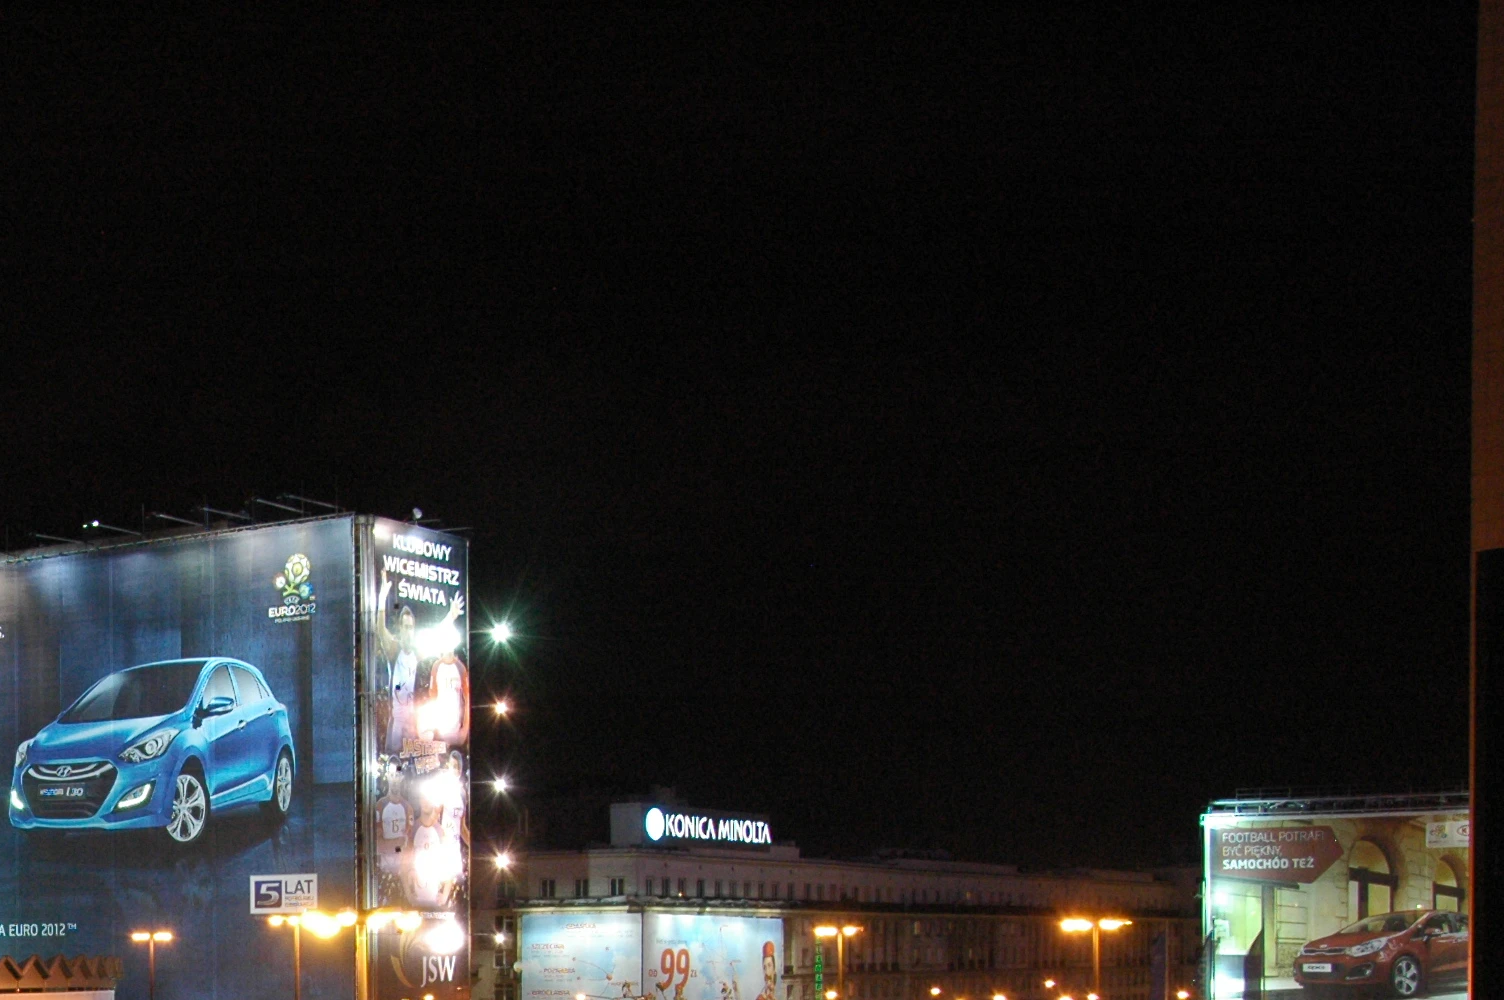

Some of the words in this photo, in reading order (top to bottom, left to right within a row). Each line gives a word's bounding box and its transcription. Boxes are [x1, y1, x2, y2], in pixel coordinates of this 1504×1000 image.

[392, 534, 452, 561] KLUBOWY
[383, 555, 460, 586] WICEMISTRZ
[398, 578, 446, 606] ŚWIATA
[268, 602, 316, 618] EURO2012
[665, 812, 715, 840] KONICA
[718, 816, 772, 844] MINOLTA
[1222, 831, 1275, 844] FOOTBALL
[1278, 829, 1324, 842] POTRAFI
[1222, 844, 1242, 857] BYĆ
[1222, 858, 1289, 870] SAMOCHÓD
[1292, 855, 1315, 869] TEŻ
[257, 882, 280, 905] 5
[284, 879, 314, 895] LAT
[8, 923, 38, 937] EURO
[421, 955, 456, 989] JSW
[661, 948, 690, 993] 99
